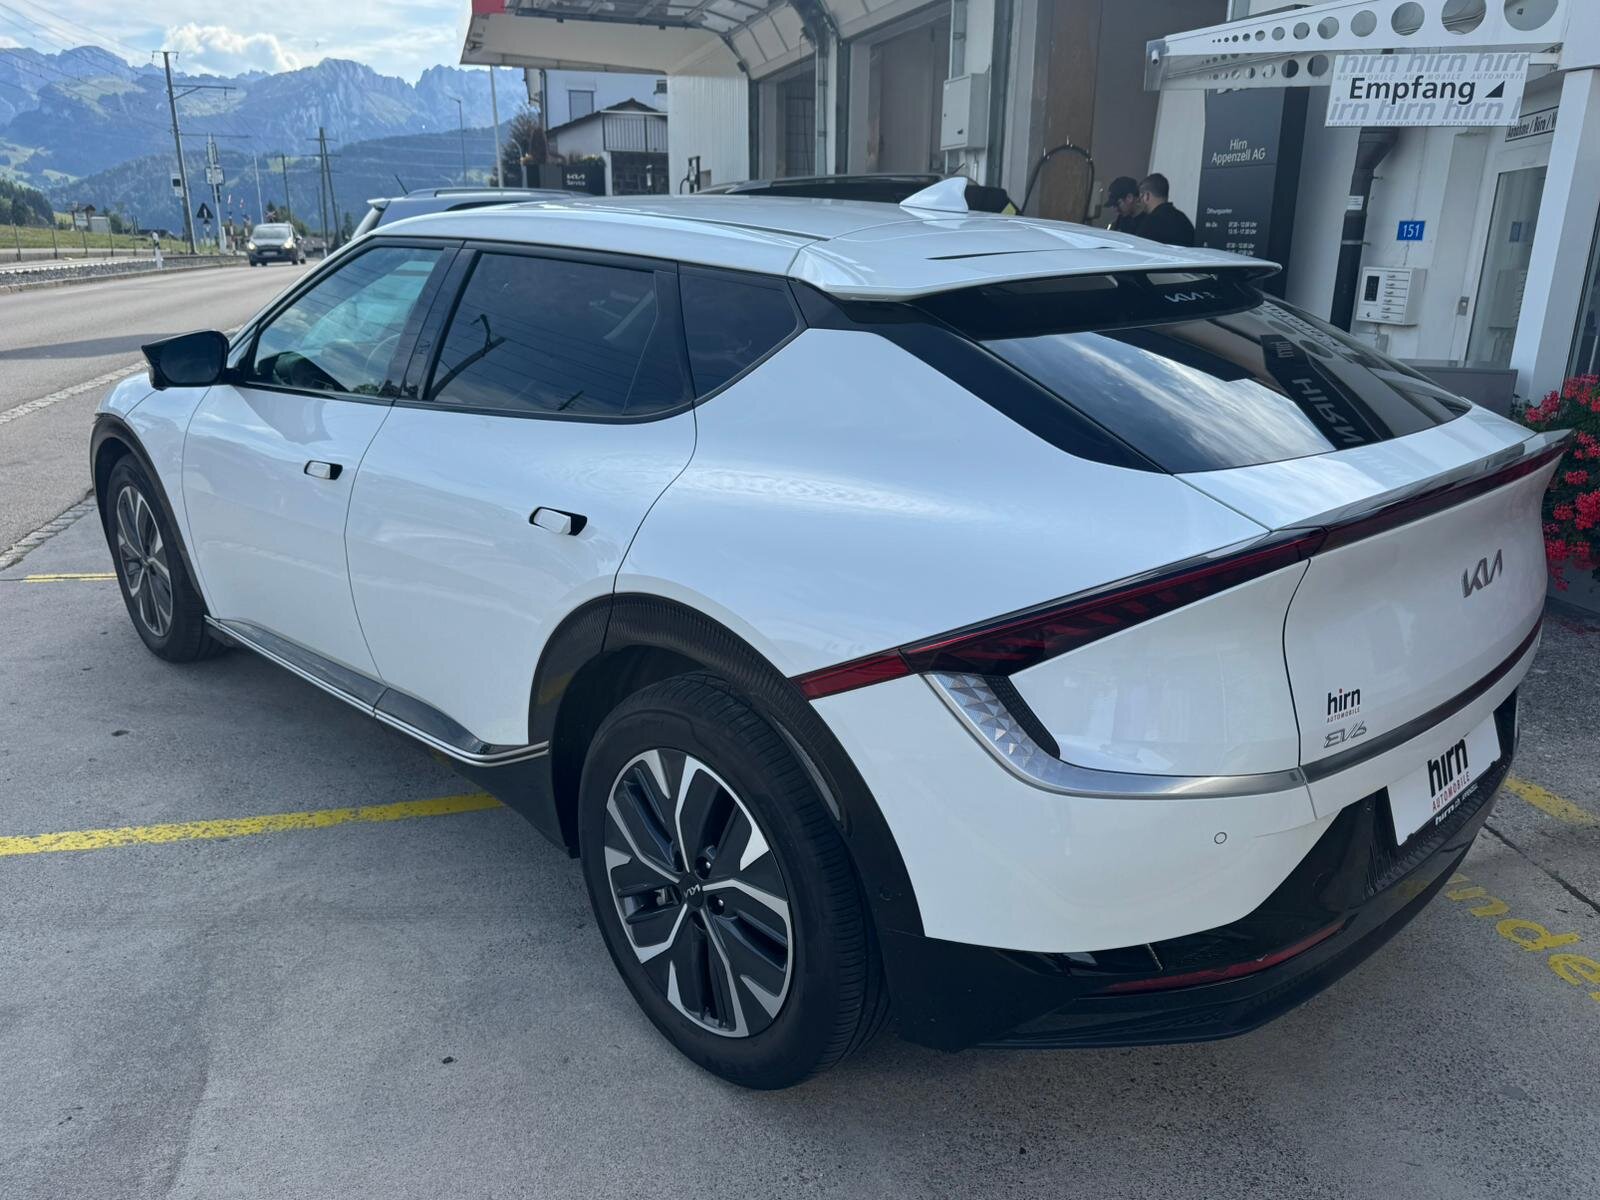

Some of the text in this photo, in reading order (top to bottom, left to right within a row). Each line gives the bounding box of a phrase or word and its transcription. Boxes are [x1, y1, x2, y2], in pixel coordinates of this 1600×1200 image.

[1349, 75, 1476, 105] Empfang
[1229, 138, 1247, 151] Hirn
[1211, 147, 1266, 166] Appenzell AG
[1403, 223, 1420, 238] 151
[1327, 688, 1360, 716] hirn
[1327, 706, 1360, 724] AUTOMOBILE
[1324, 720, 1367, 748] EV6
[1432, 771, 1470, 812] AUTOMOBILE
